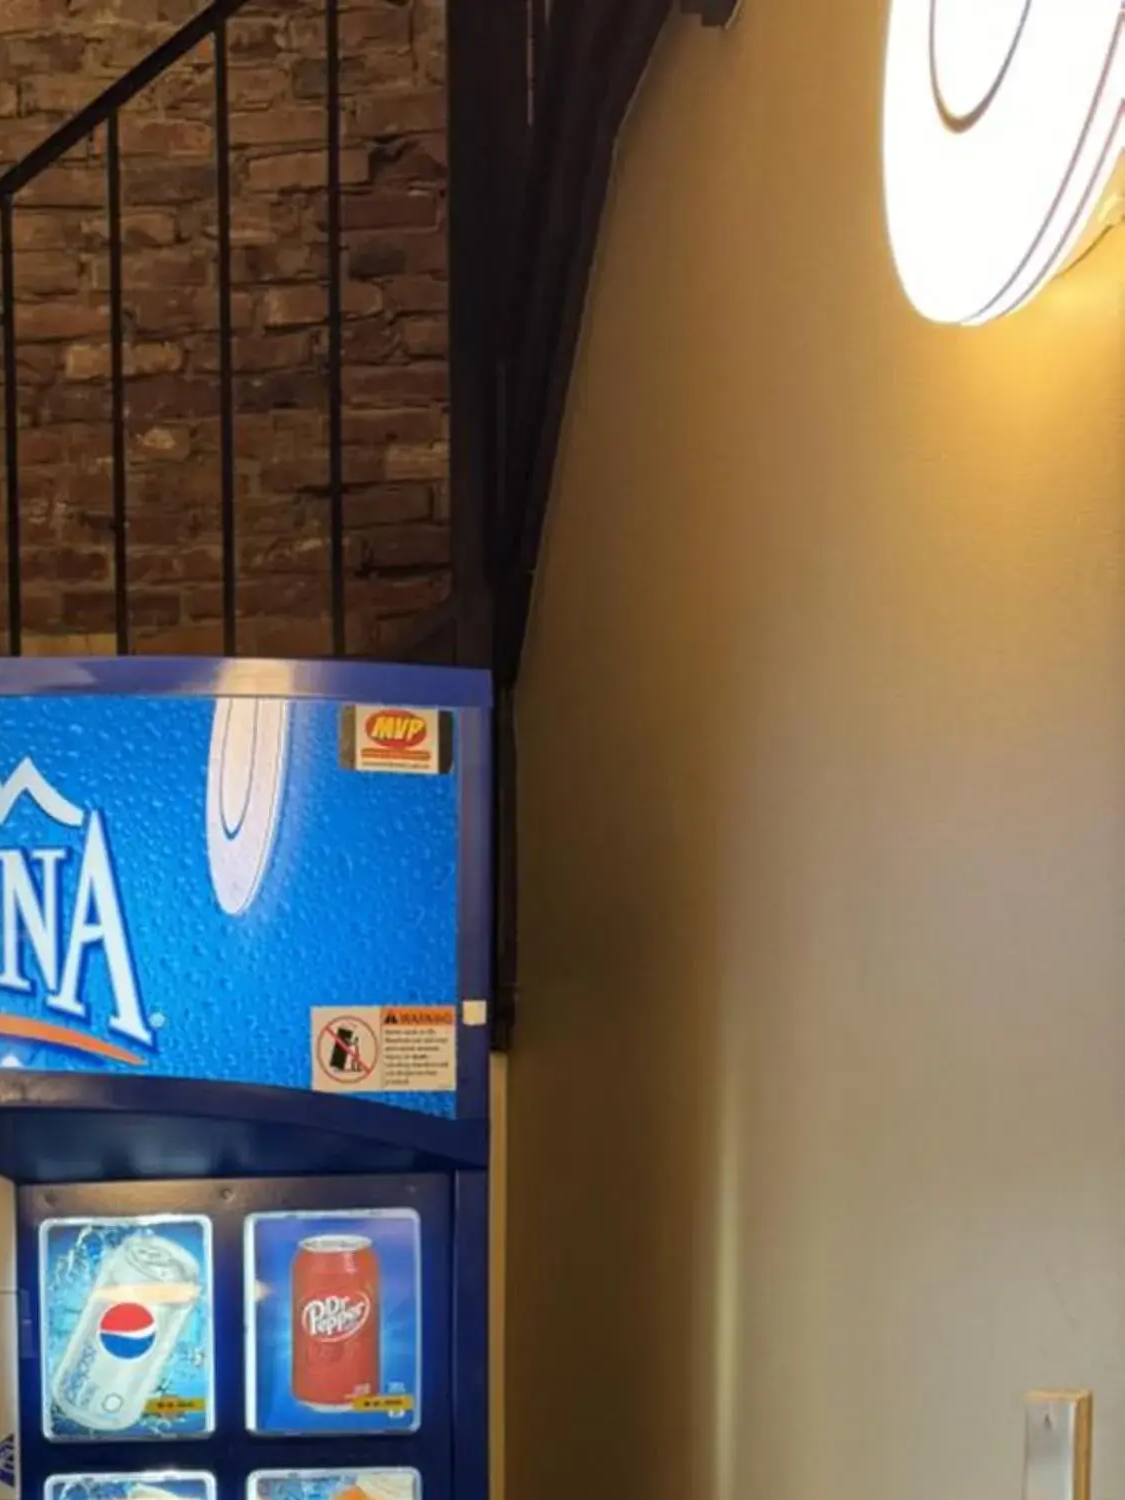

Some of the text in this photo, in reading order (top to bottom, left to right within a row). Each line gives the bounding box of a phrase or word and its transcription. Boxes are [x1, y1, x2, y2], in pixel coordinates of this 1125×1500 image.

[371, 716, 425, 741] MVP
[308, 1300, 365, 1336] Pepper
[325, 1296, 351, 1319] Dr
